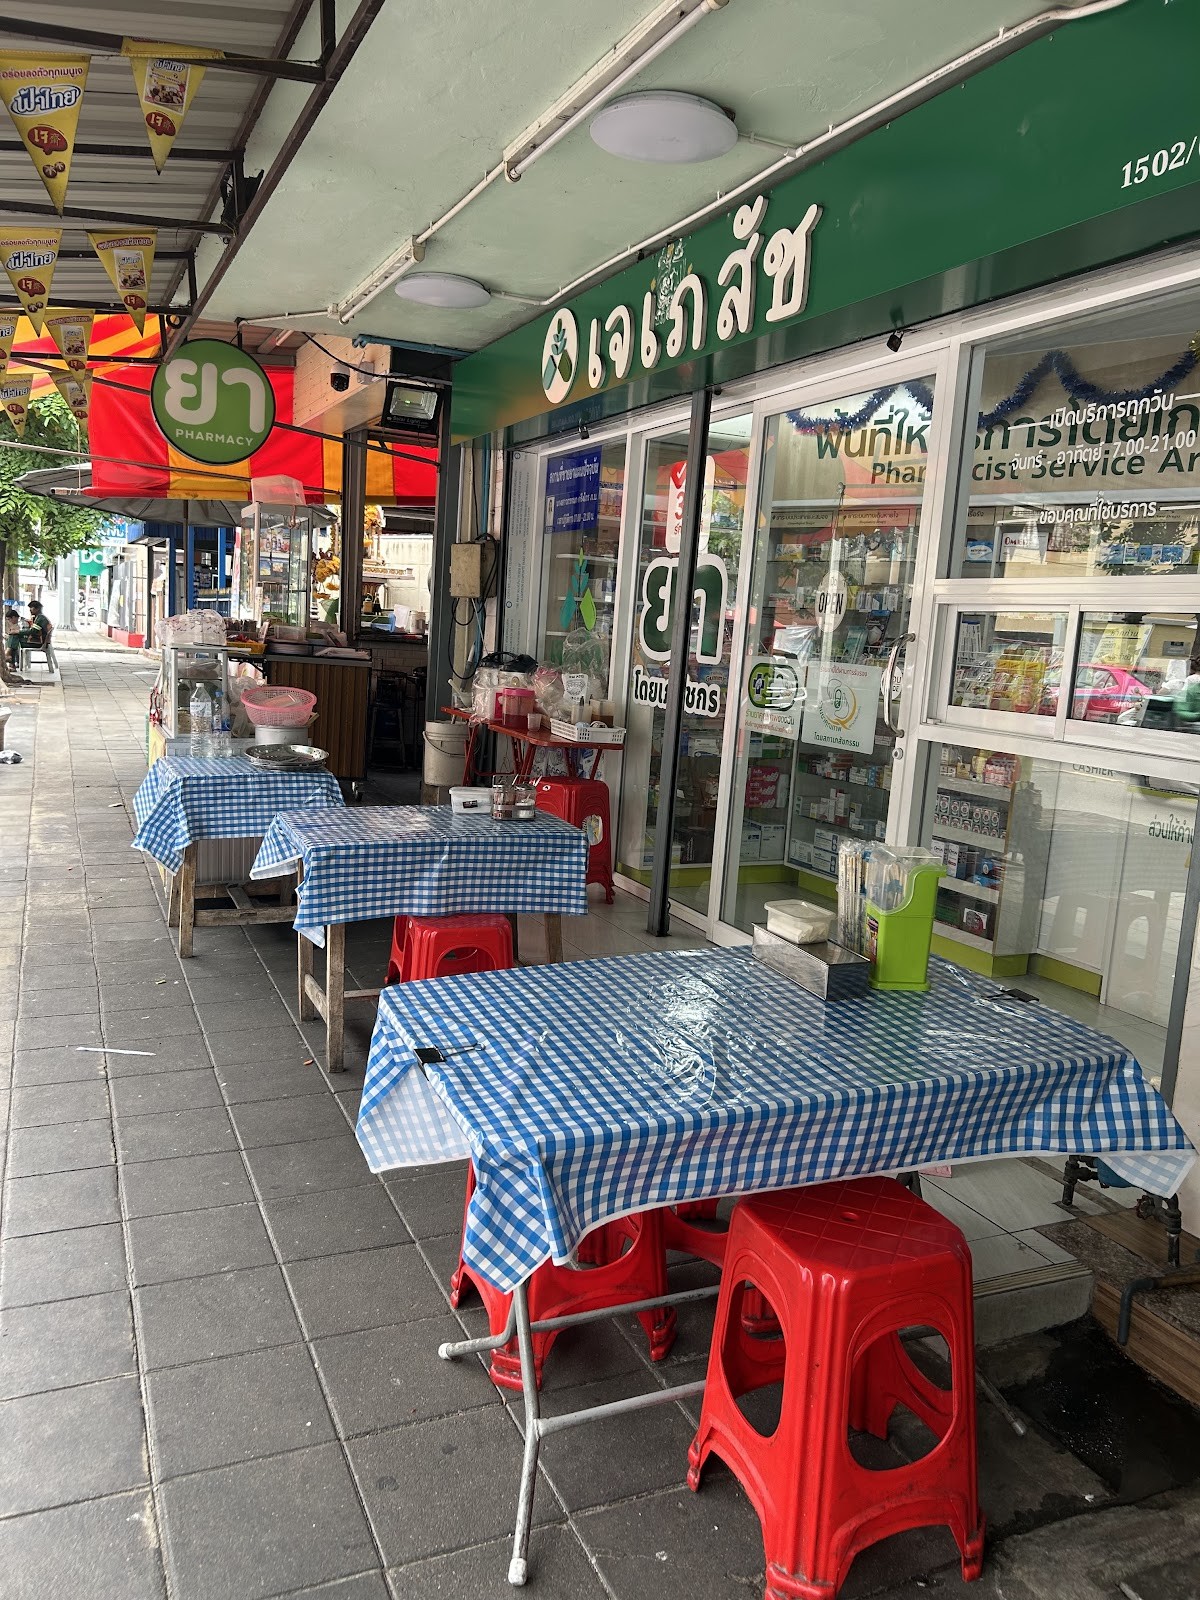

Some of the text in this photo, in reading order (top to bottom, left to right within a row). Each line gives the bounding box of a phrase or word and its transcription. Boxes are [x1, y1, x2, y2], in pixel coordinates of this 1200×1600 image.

[12, 86, 80, 114] ฟ้าไทย
[33, 128, 49, 144] เจ
[1121, 136, 1200, 189] 1502/
[7, 251, 56, 270] ฟ้าไทย
[588, 195, 822, 389] เจเภสัช
[165, 358, 266, 434] ยา
[1050, 388, 1174, 429] เปิดบริการทุกวัน
[175, 429, 254, 447] PHARMACY
[1011, 450, 1043, 471] จันทร์
[1113, 429, 1197, 458] 7.00-21.00
[1040, 495, 1157, 530] ขอบคุณที่ใช้บริการ
[819, 592, 844, 615] OPEN
